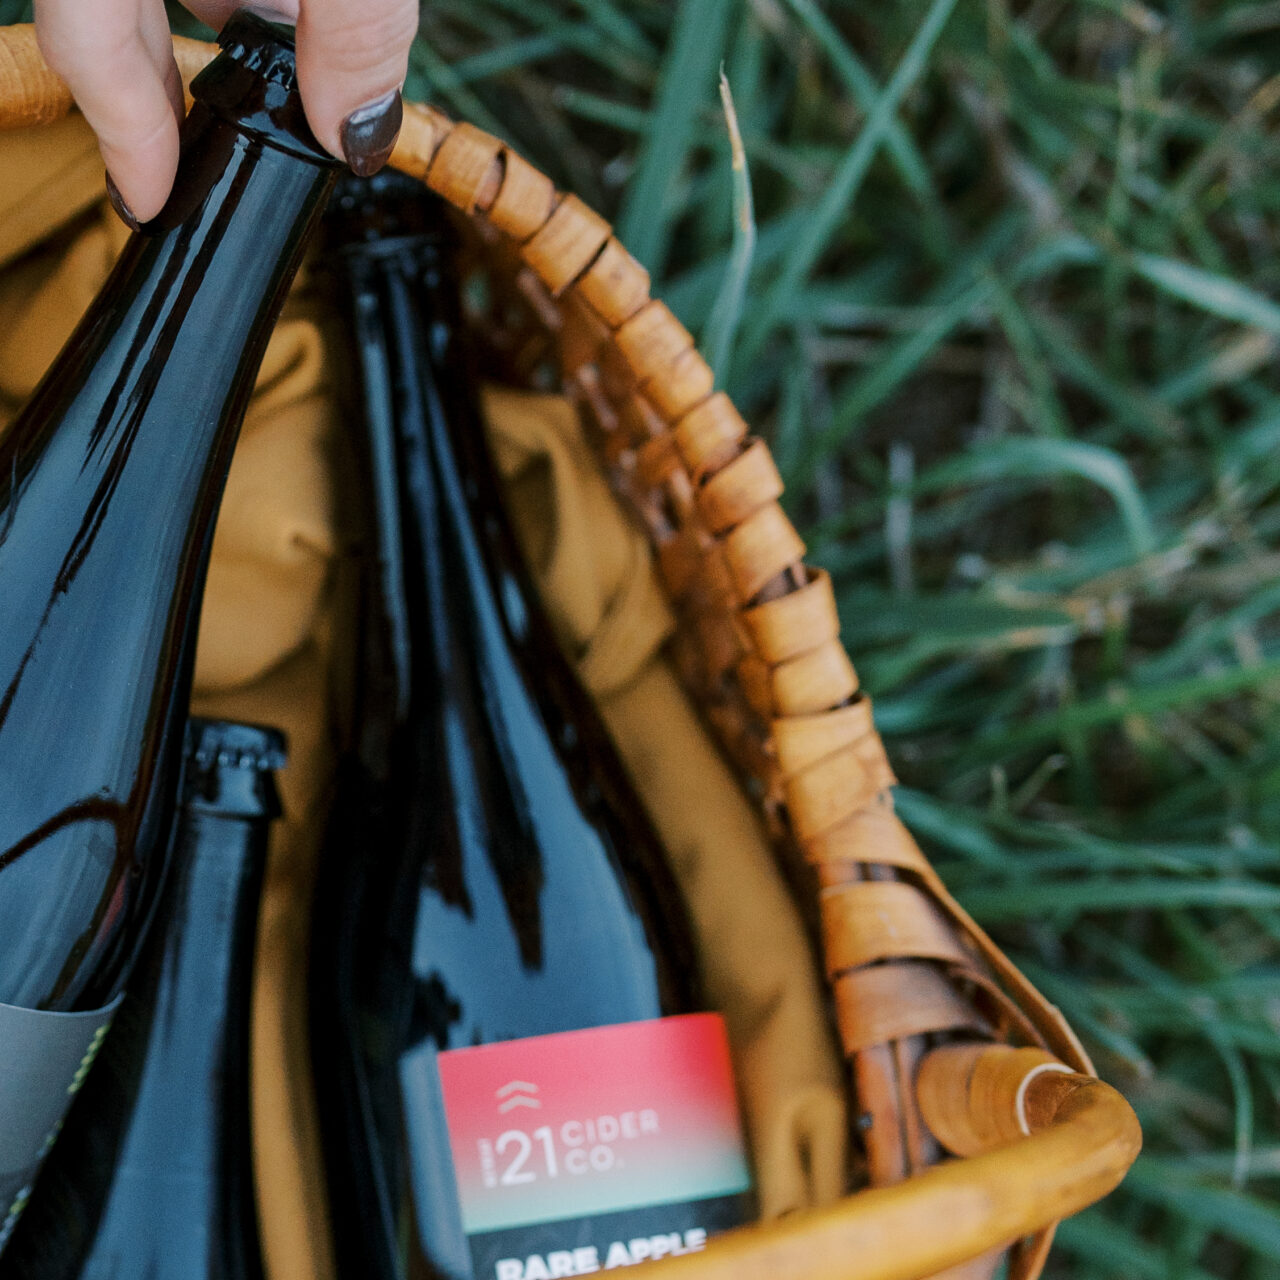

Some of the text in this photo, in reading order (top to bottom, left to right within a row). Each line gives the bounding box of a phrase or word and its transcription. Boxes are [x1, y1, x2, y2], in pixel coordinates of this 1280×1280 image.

[495, 1125, 558, 1186] 21
[560, 1109, 659, 1147] CIDER
[604, 1227, 707, 1270] APPLE
